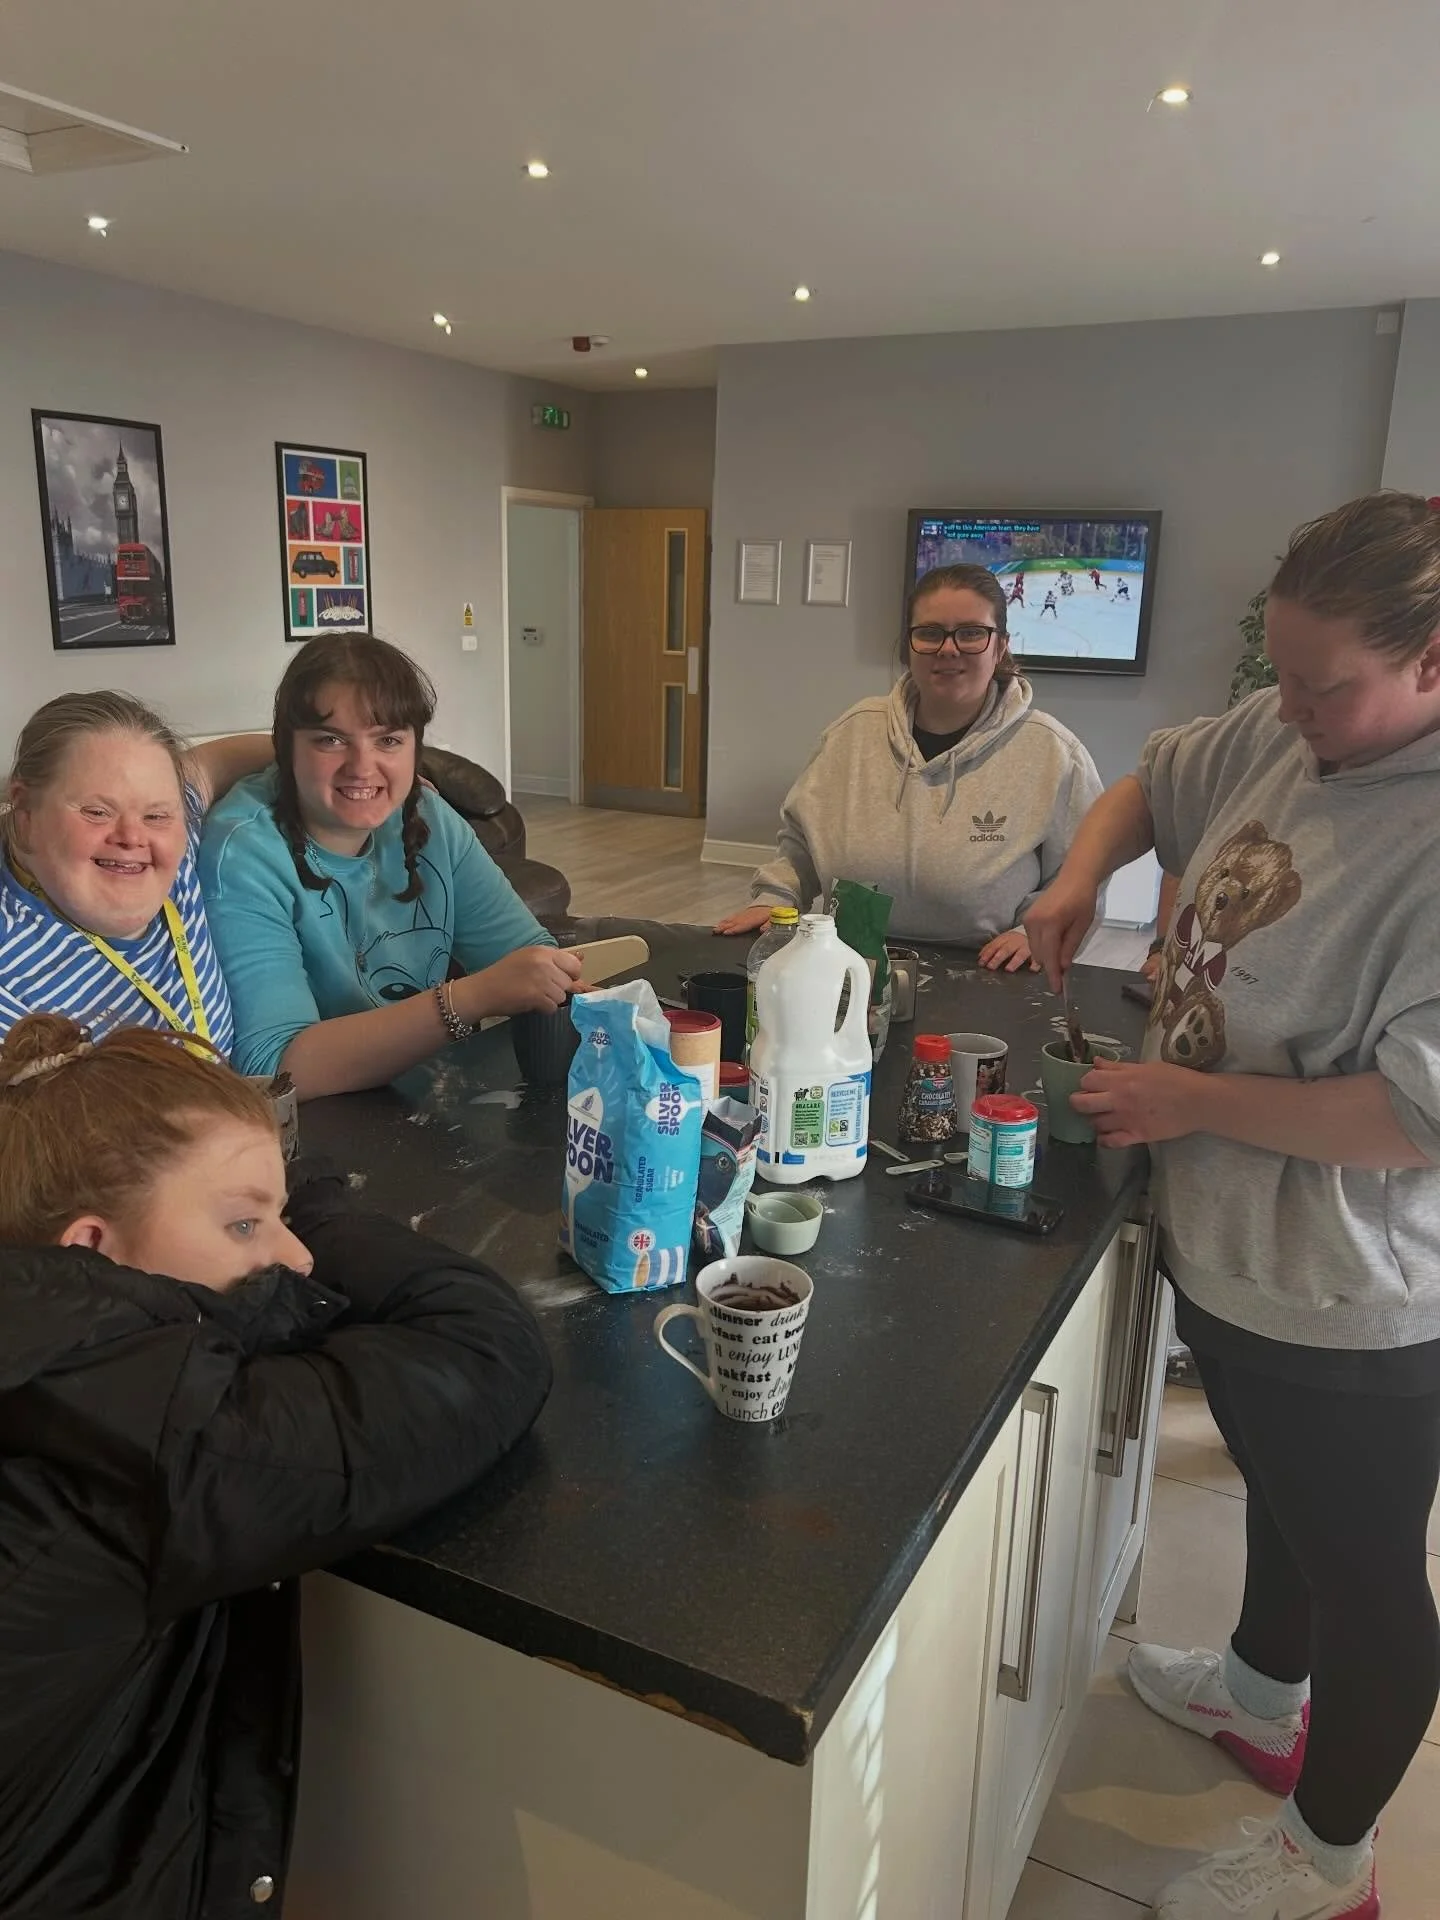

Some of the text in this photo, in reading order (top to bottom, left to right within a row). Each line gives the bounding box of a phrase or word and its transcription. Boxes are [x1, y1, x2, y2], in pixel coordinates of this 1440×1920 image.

[1014, 525, 1026, 533] they
[969, 833, 1005, 842] adidas
[1230, 966, 1259, 985] 1997
[658, 1082, 671, 1135] SILVER
[568, 1113, 613, 1159] LVER
[568, 1142, 614, 1184] OON
[635, 1156, 647, 1203] GRANULATED
[646, 1168, 655, 1193] SUGAR
[770, 1306, 804, 1327] drink
[752, 1332, 779, 1345] eat
[728, 1347, 775, 1370] enjoy
[732, 1388, 764, 1401] enjoy
[725, 1401, 768, 1421] Lunch
